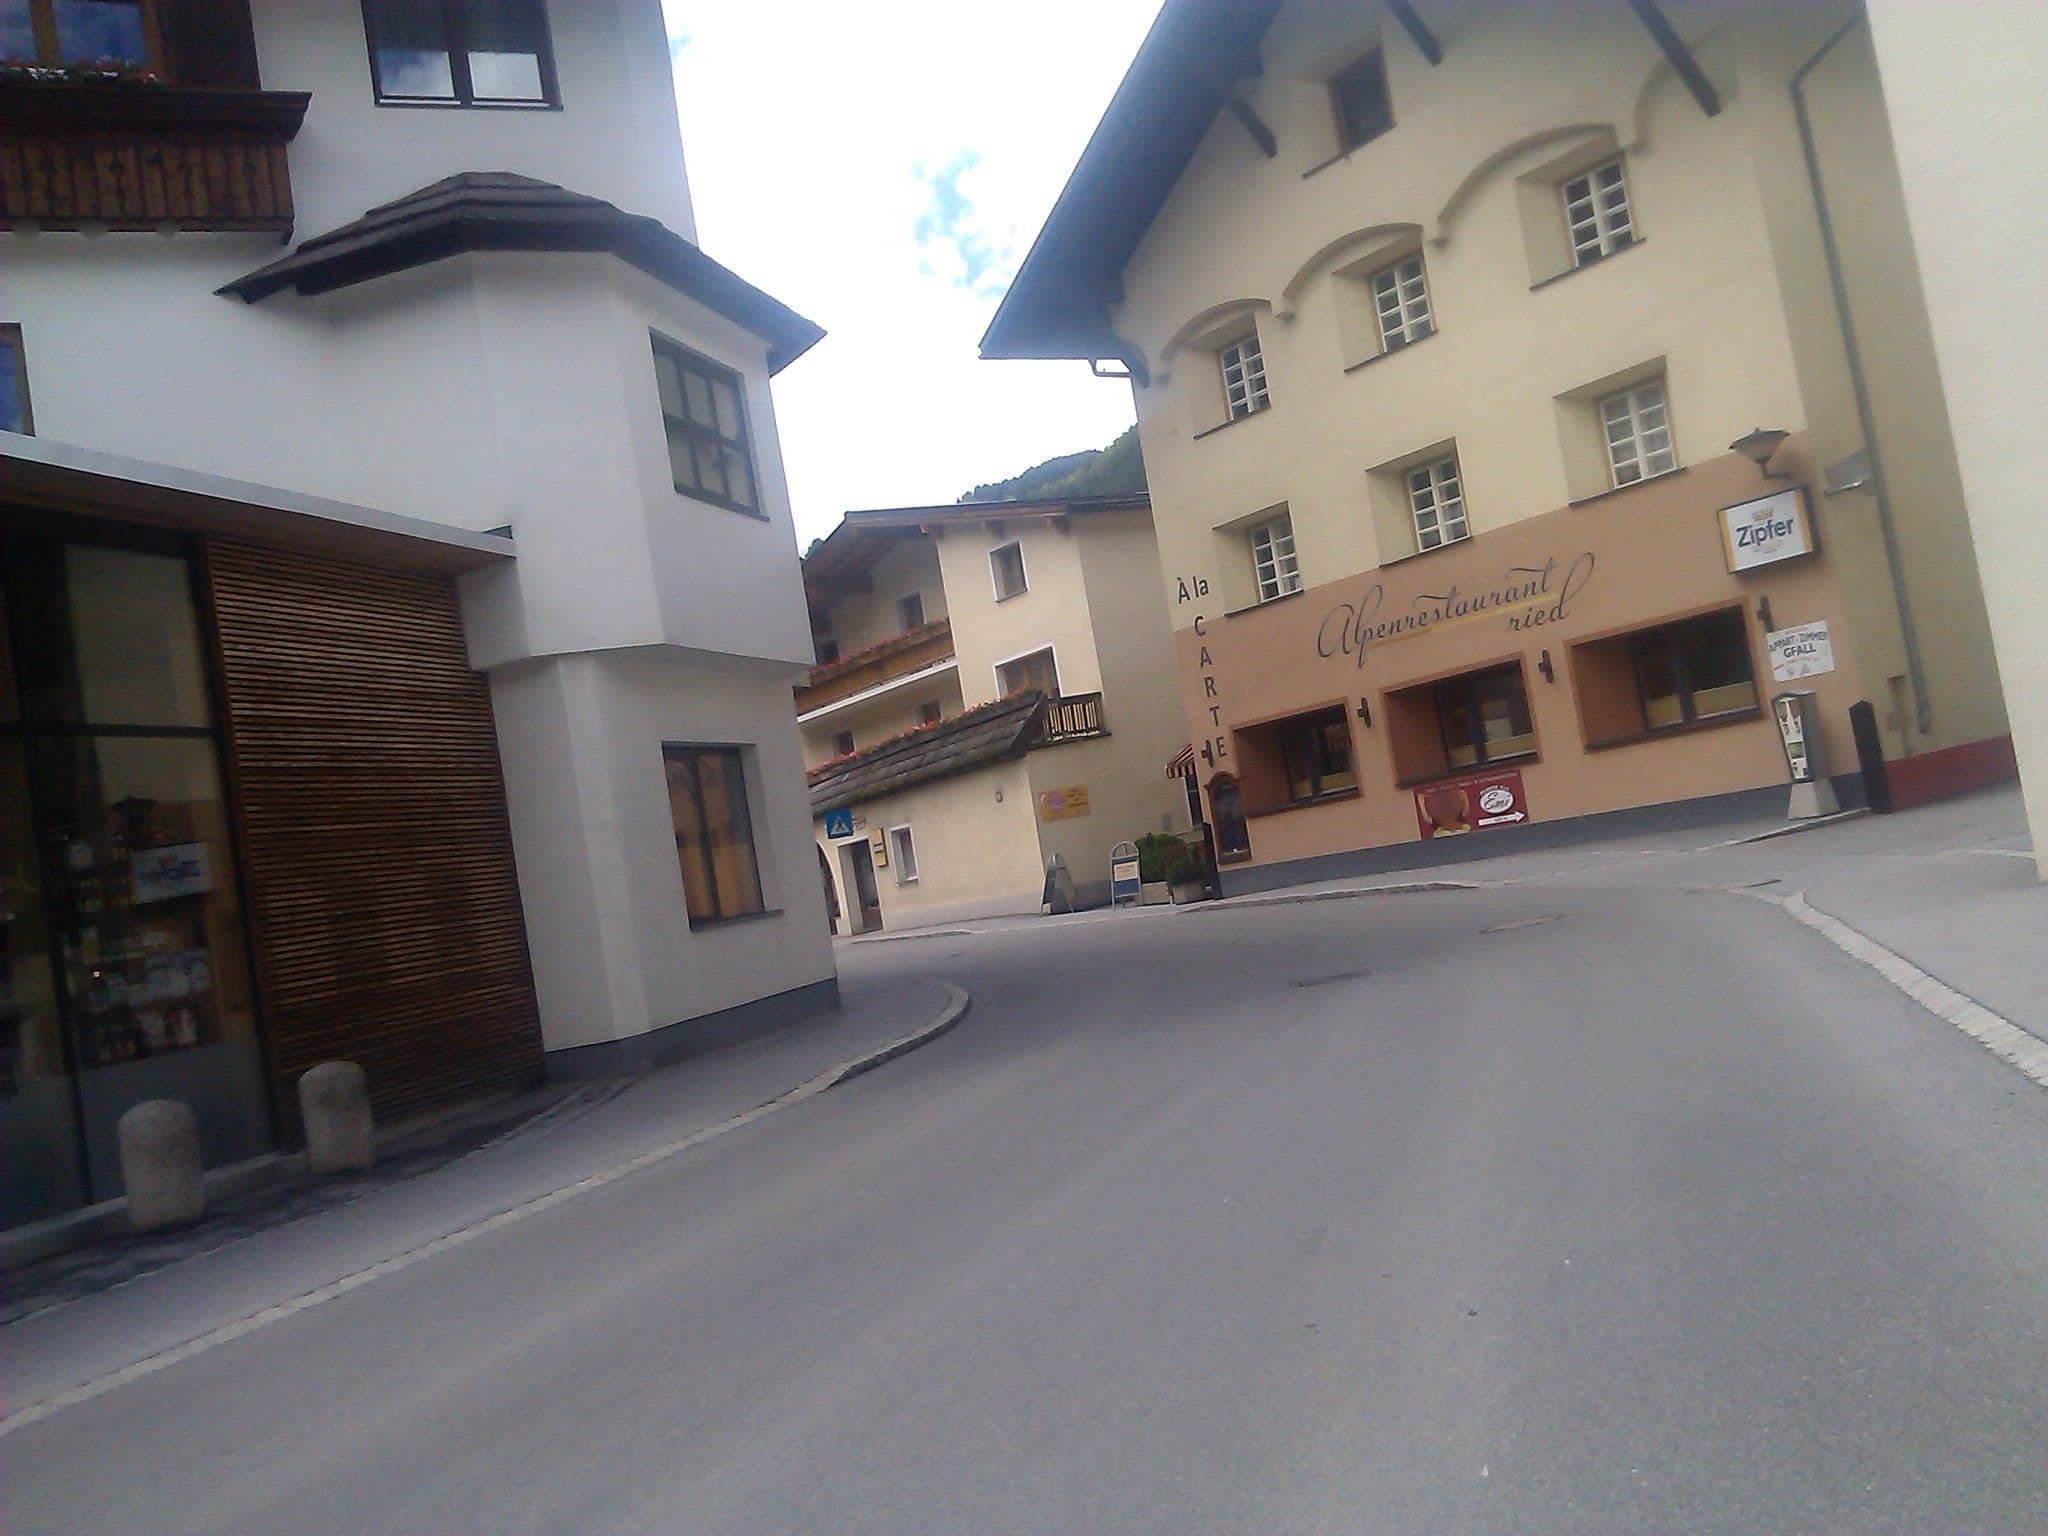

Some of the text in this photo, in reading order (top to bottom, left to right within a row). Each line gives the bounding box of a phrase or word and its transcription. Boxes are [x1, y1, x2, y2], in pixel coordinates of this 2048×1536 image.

[1736, 518, 1794, 548] Zipfer
[1176, 575, 1210, 604] À la
[1317, 557, 1557, 669] Alpenrestaurant
[1508, 552, 1595, 632] ried
[1783, 643, 1816, 658] GFALL
[1194, 615, 1227, 758] CARTE
